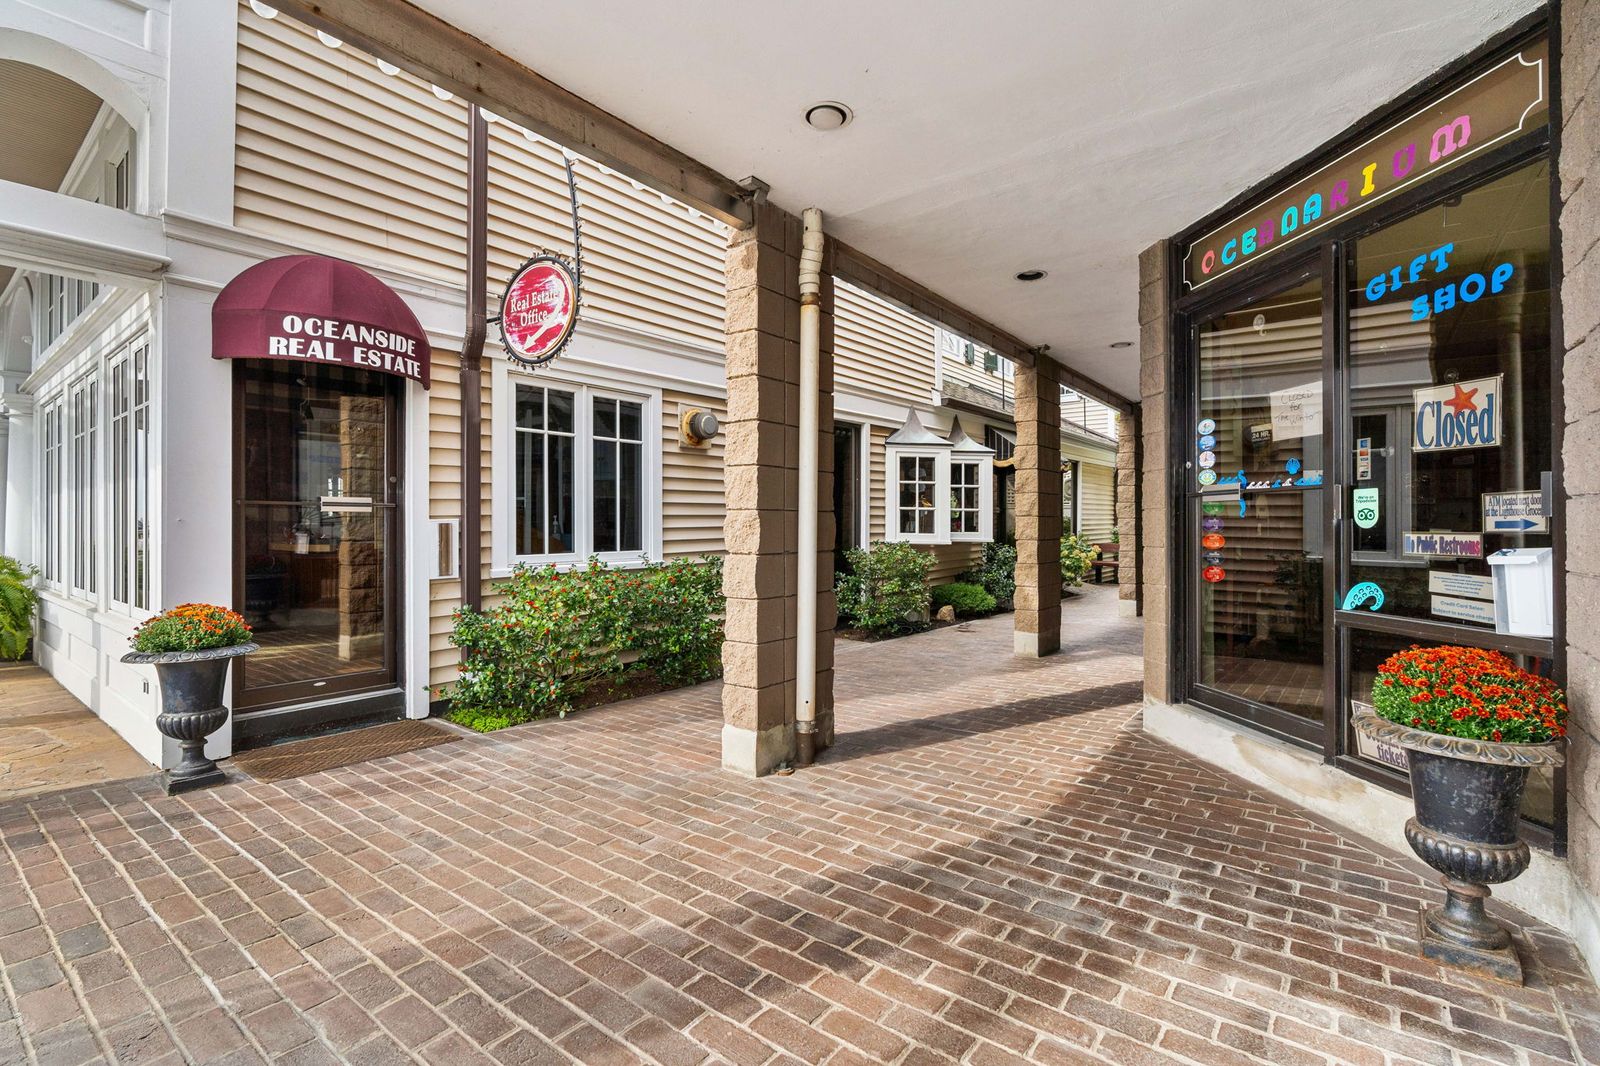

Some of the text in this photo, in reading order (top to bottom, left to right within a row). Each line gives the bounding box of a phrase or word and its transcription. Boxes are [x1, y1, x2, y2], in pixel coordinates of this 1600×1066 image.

[1201, 115, 1471, 274] OCEANARIUM
[1365, 243, 1454, 302] GIFT
[1410, 262, 1514, 322] SHOP
[510, 294, 529, 313] Real
[520, 310, 548, 327] Office
[269, 336, 421, 378] REAL ESTATE
[282, 315, 416, 357] OCEANSIDE
[1416, 393, 1495, 449] Closed
[1488, 495, 1500, 506] ATM
[1501, 494, 1517, 507] located
[1416, 534, 1437, 554] Public
[1439, 535, 1480, 557] Restrooms
[1377, 744, 1409, 768] tickets
